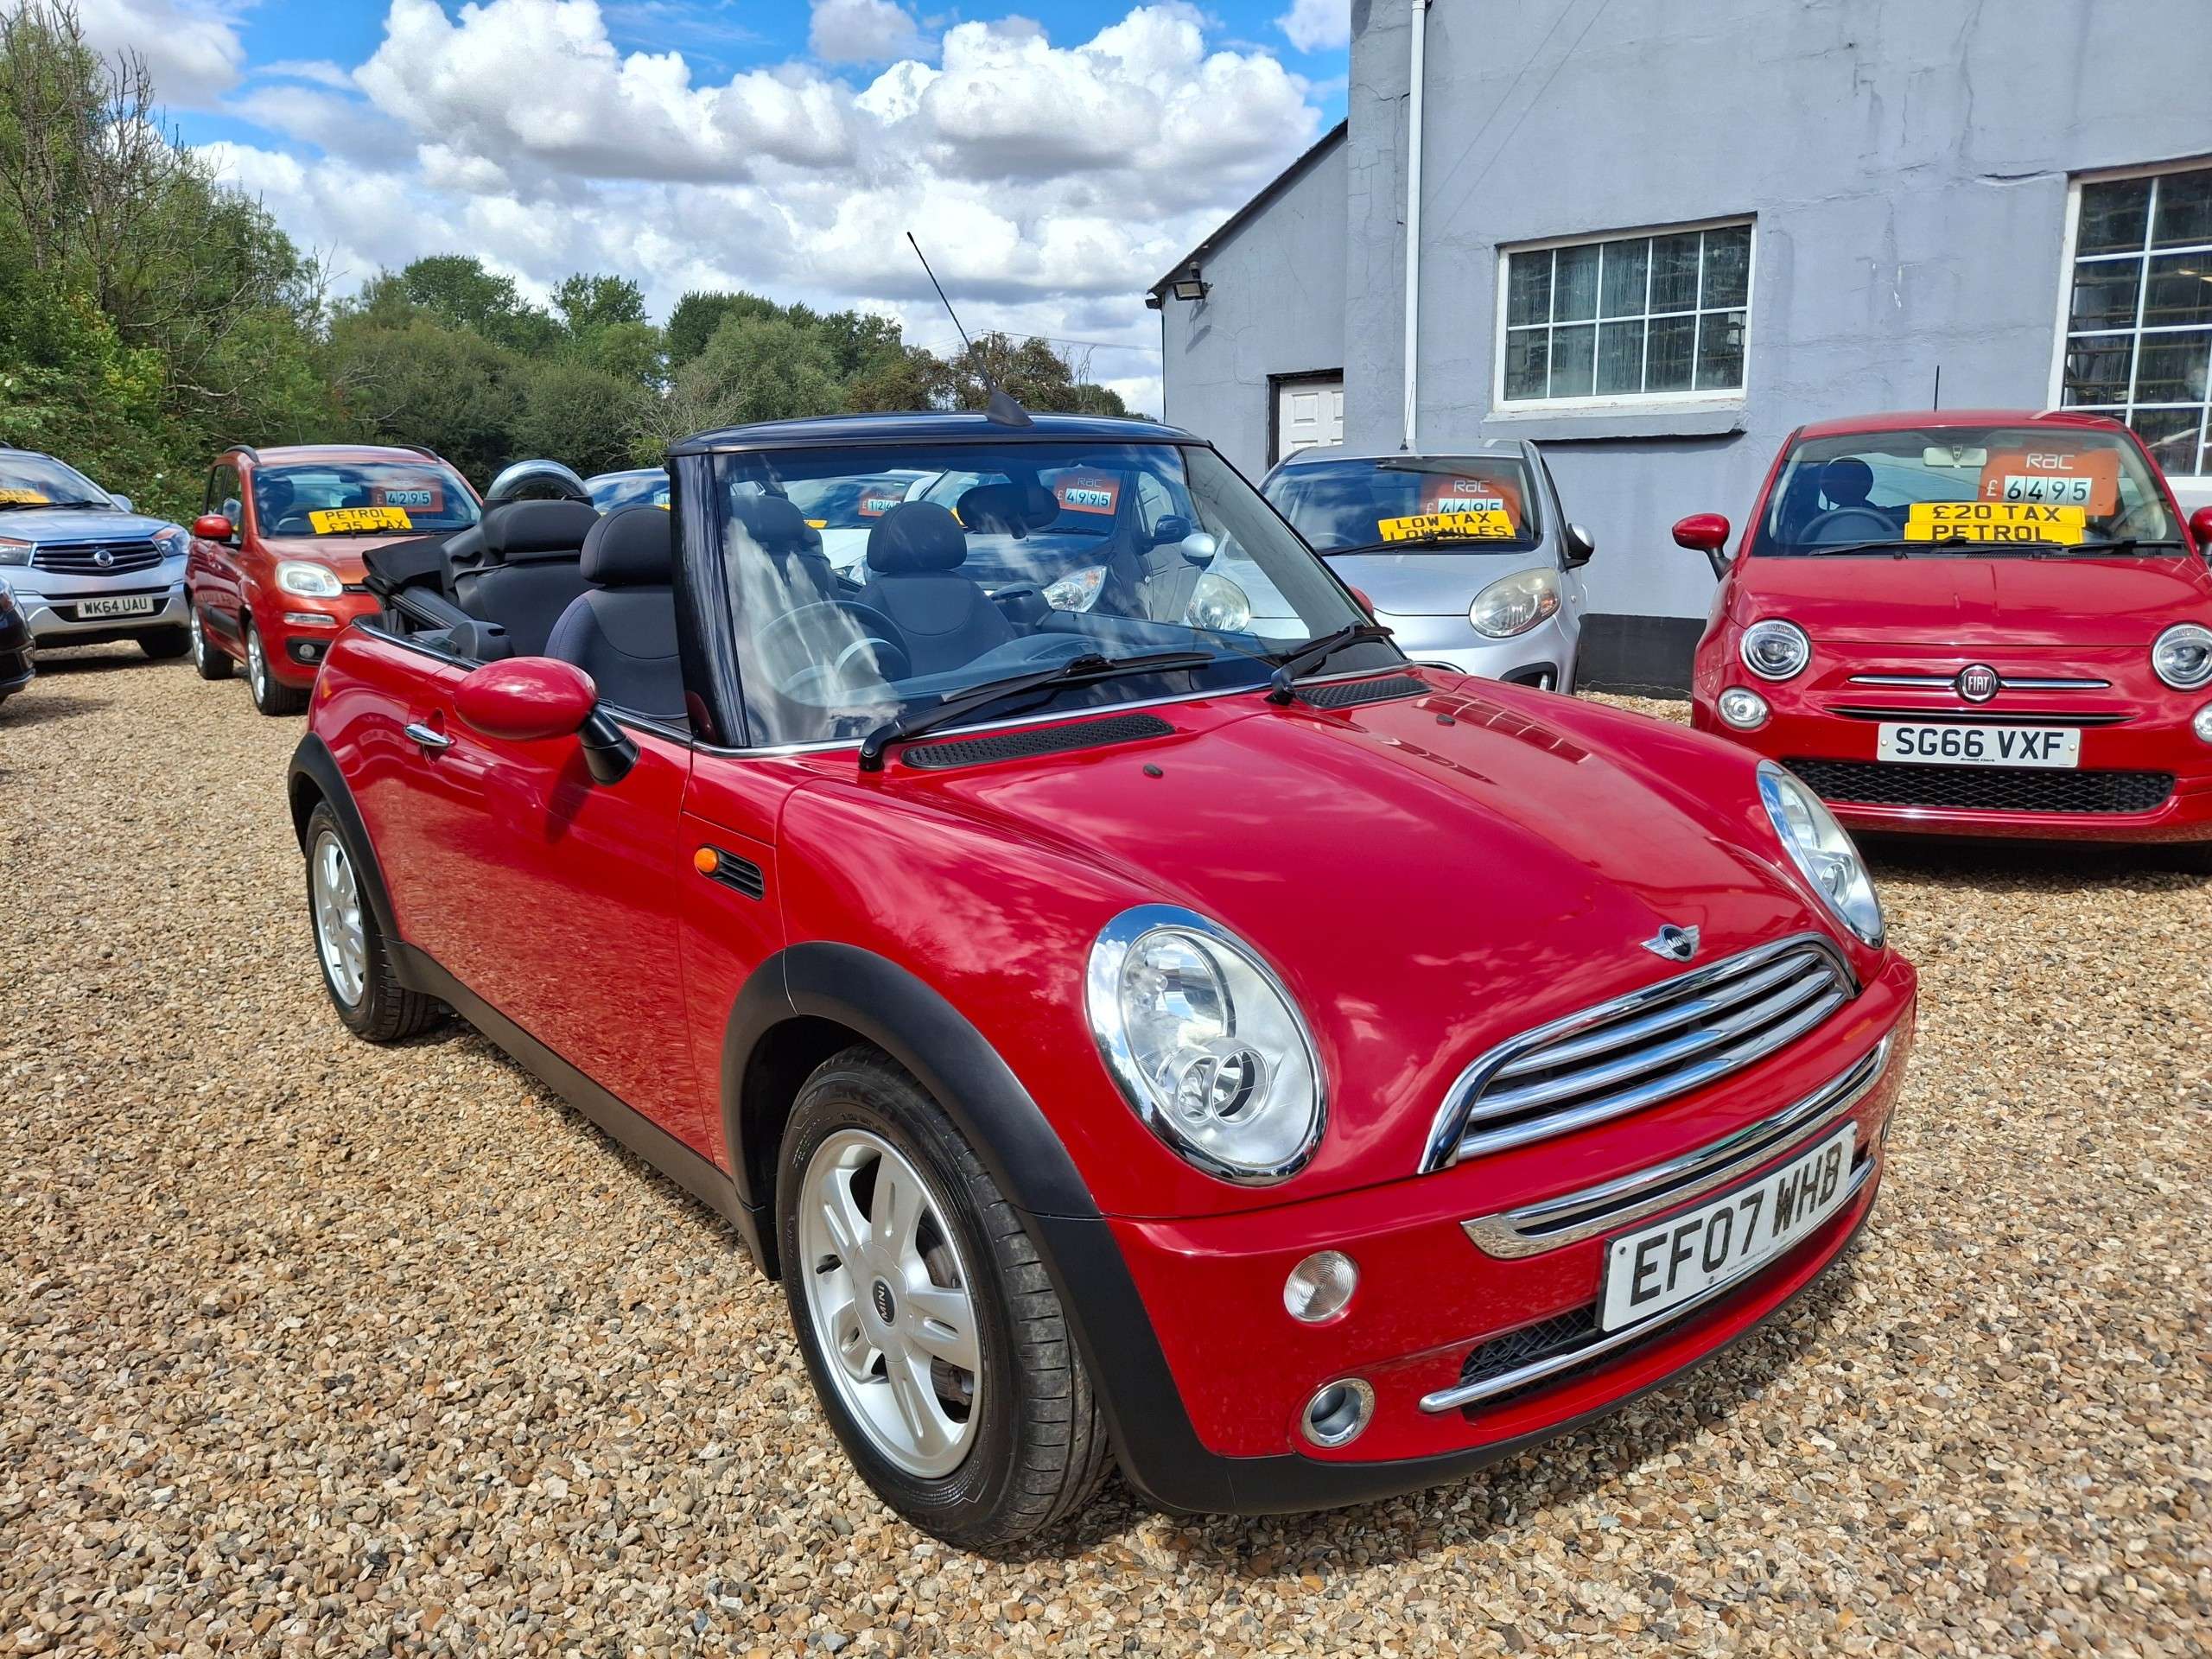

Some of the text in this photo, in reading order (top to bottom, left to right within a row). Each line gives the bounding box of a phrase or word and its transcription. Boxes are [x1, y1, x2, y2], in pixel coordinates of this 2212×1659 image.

[325, 508, 391, 521] PETROL
[1395, 512, 1492, 530] LOW TAX
[1932, 505, 2061, 523] £20 TAX
[372, 519, 408, 530] TAX
[1931, 524, 2054, 543] PETROL
[84, 597, 148, 614] WK64 UAU
[1967, 676, 1990, 691] FIAT
[1895, 727, 2064, 760] SG66 VXF
[1630, 1141, 1843, 1307] EF07 WHB
[878, 1285, 888, 1319] MINI
